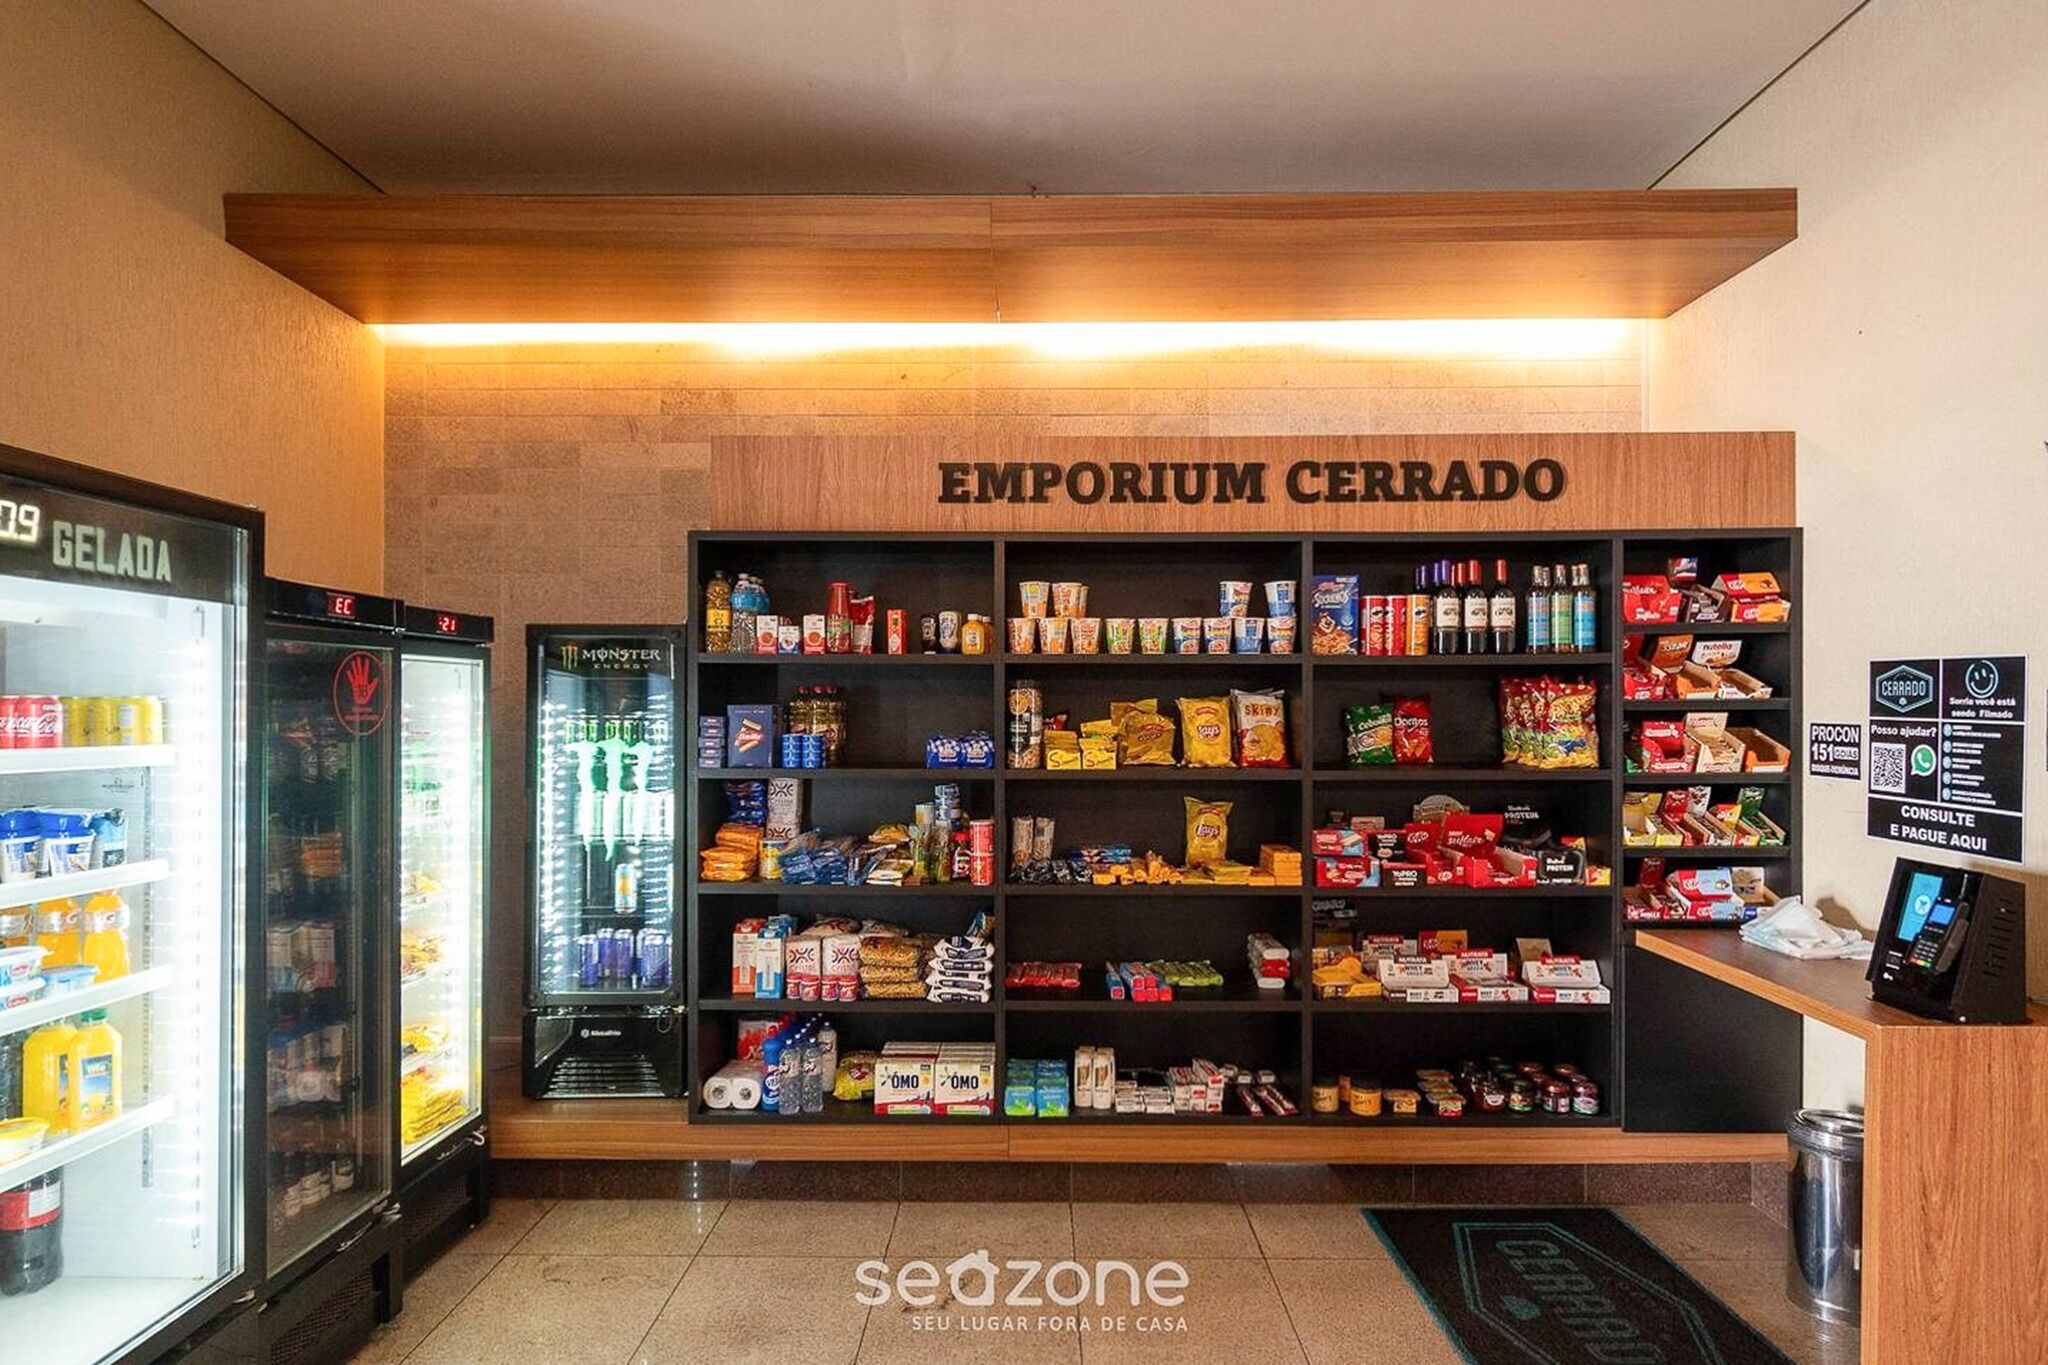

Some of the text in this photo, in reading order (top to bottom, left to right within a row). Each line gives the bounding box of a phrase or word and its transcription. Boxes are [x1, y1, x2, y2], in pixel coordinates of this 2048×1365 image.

[938, 459, 1567, 503] EMPORIUM CERRADO
[53, 520, 172, 583] GELADA
[582, 648, 662, 662] MONSTER
[1882, 681, 1926, 697] CERRADO
[1949, 697, 2016, 706] Sorria você está
[1951, 709, 1976, 718] sendo
[1394, 717, 1428, 731] Doritos
[1871, 724, 1937, 738] Posso ajudar?
[1811, 725, 1860, 743] PROCON
[1811, 743, 1834, 761] 151
[1900, 805, 1976, 828] CONSULTE
[1890, 823, 1987, 851] E PAGUE AQUI
[891, 1071, 919, 1089] ÓMO
[951, 1072, 979, 1089] ÓMO
